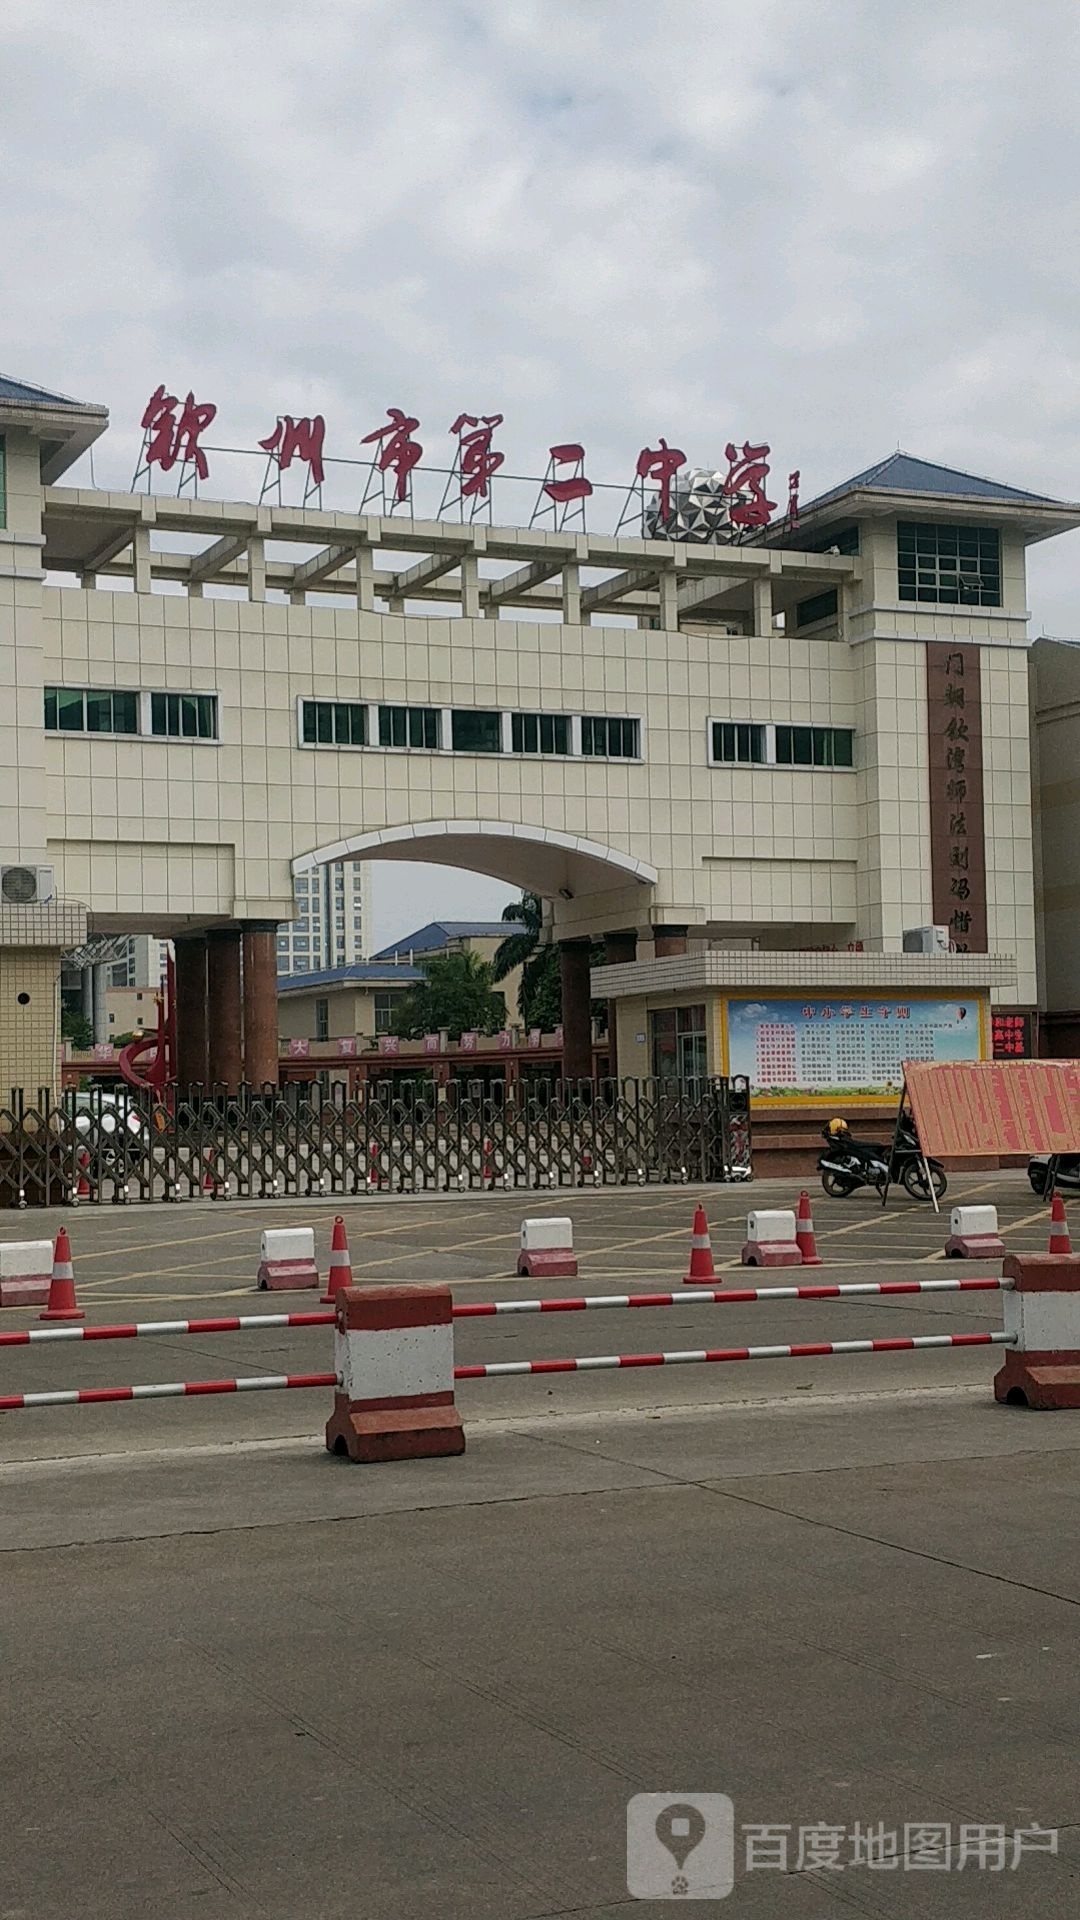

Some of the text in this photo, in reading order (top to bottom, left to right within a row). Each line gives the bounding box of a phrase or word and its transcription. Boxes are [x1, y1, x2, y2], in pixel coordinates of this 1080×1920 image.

[141, 384, 778, 525] 钦州市第二中学
